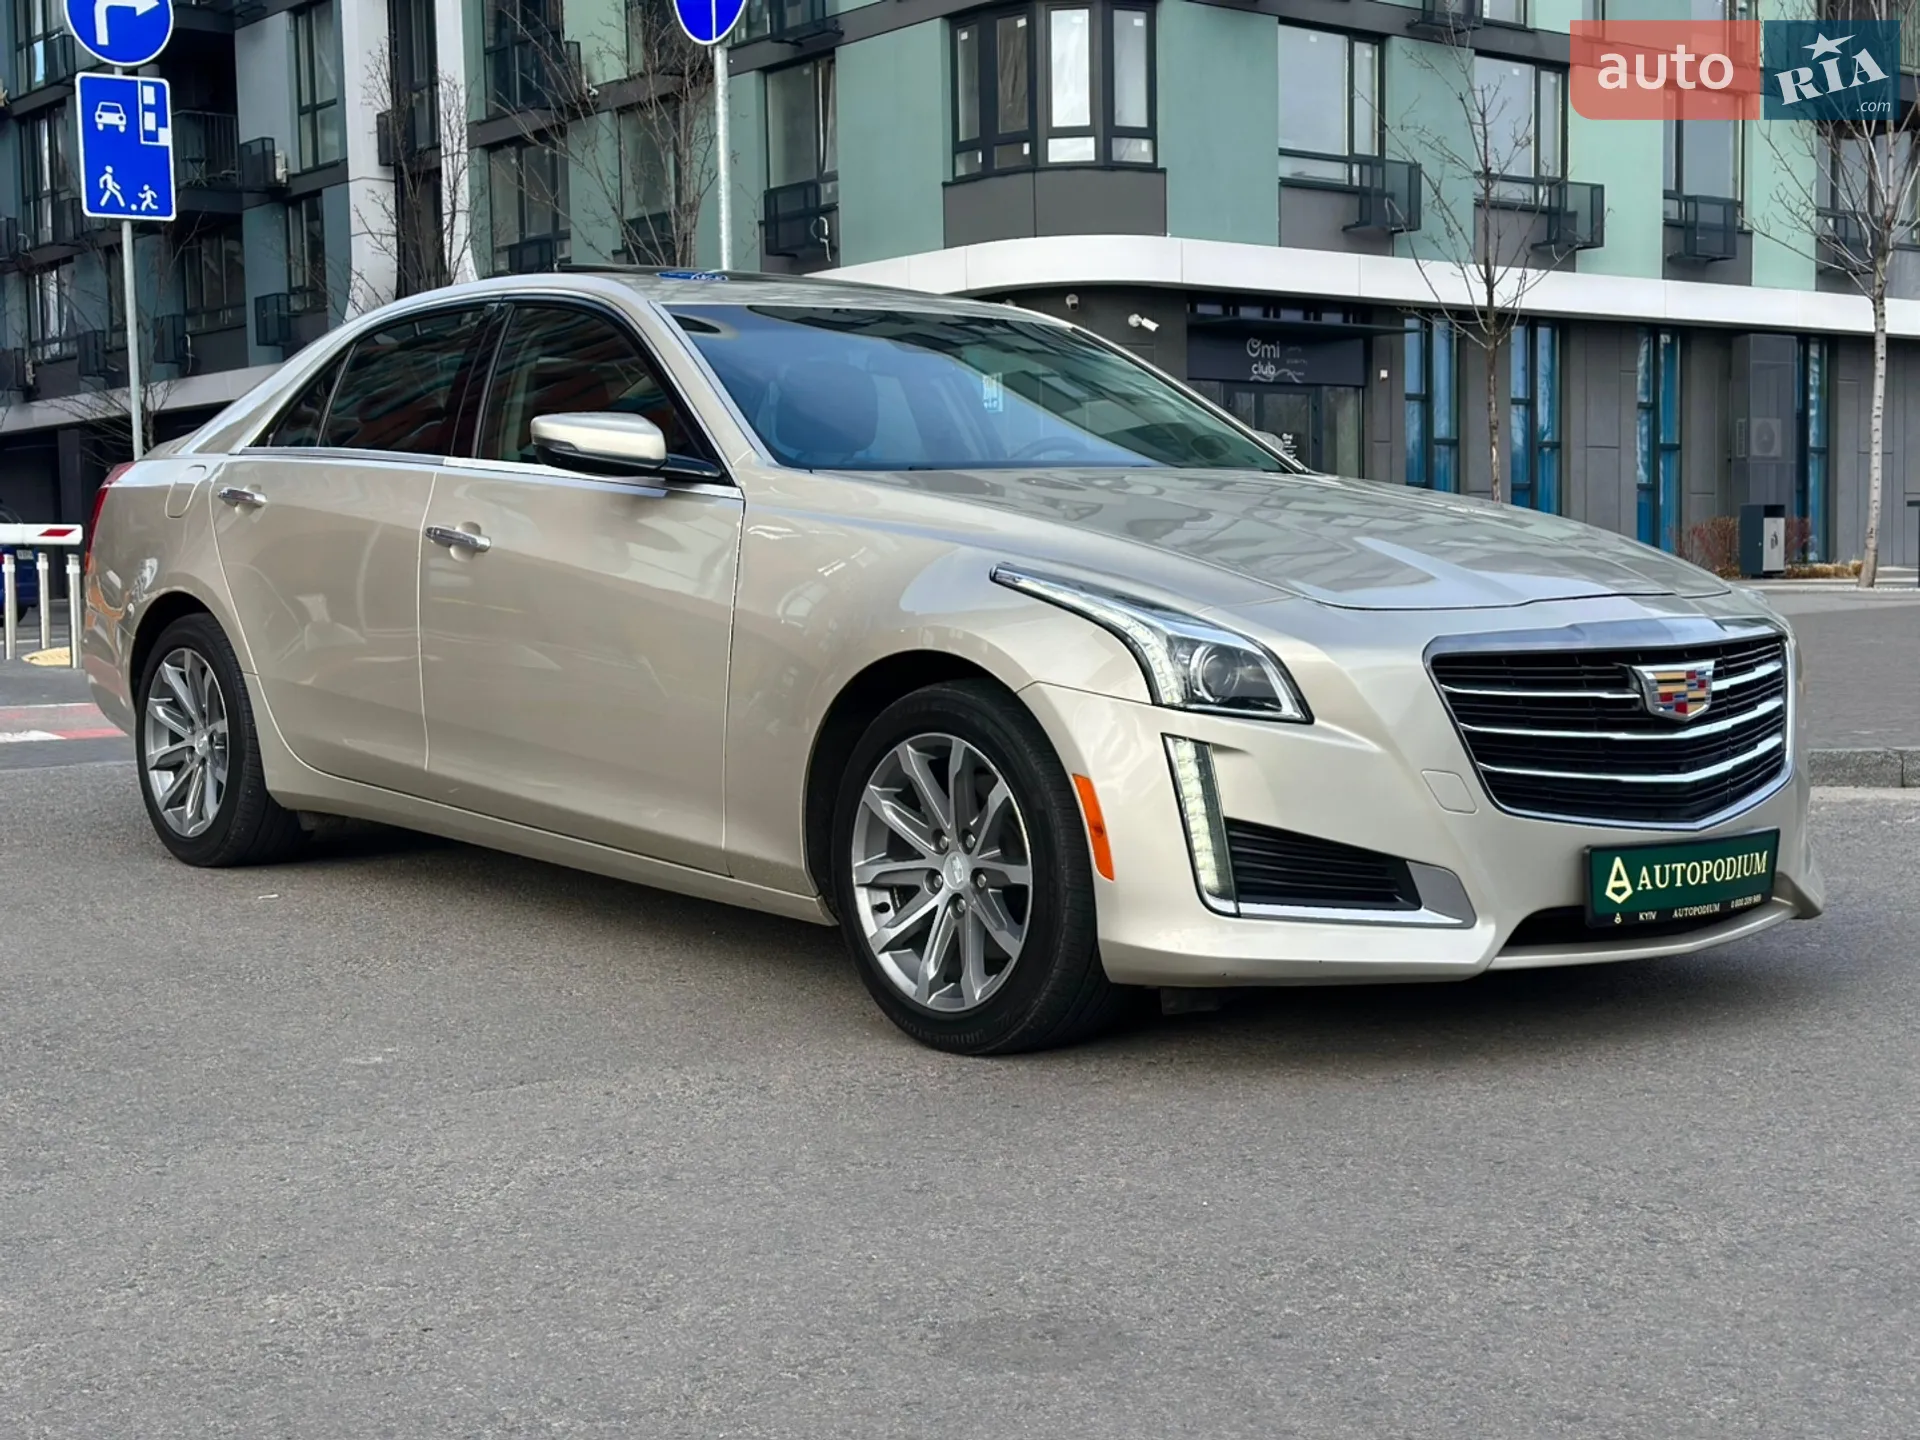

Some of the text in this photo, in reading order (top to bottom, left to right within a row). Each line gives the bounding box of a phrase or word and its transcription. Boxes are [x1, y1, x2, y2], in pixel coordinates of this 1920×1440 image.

[1251, 360, 1276, 375] club
[1637, 850, 1768, 890] AUTOPODIUM
[1638, 910, 1657, 921] KYIV
[1672, 903, 1720, 917] AUTOPODIUM
